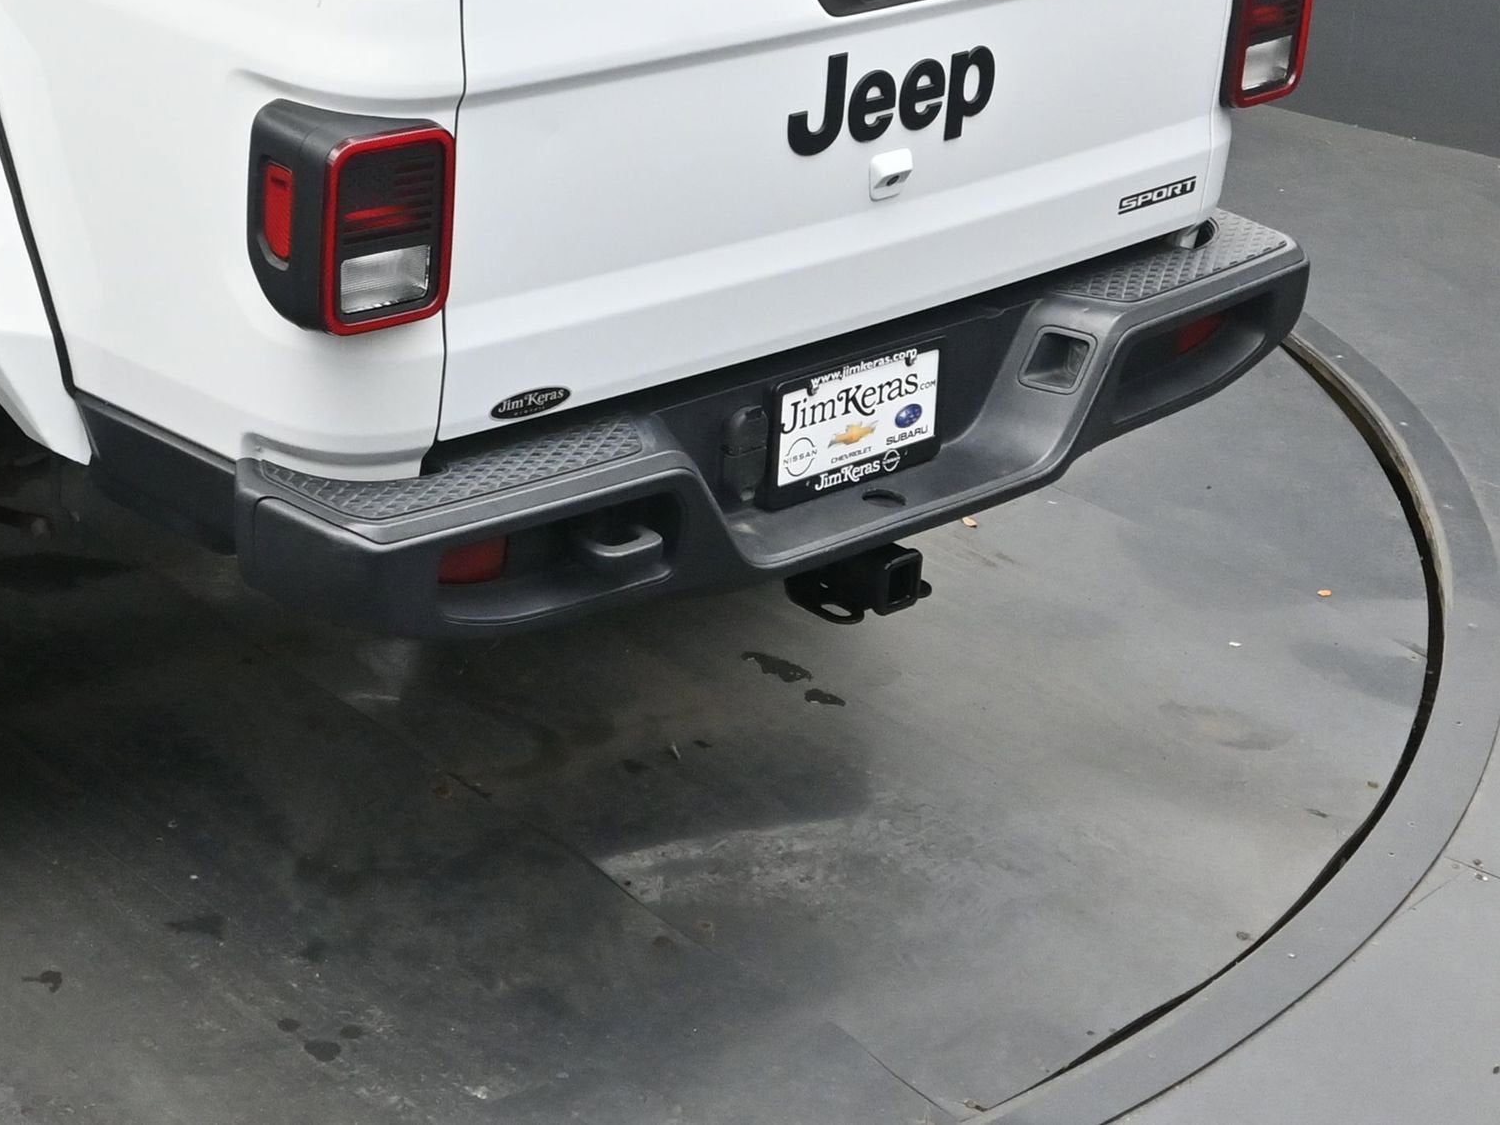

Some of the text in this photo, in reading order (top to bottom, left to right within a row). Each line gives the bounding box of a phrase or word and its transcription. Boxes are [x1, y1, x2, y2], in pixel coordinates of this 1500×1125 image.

[787, 44, 996, 157] Jeep
[1121, 179, 1196, 209] SPORT
[886, 425, 928, 445] SUBARU
[783, 447, 818, 465] NISSAN
[830, 446, 872, 464] CHEVROLET
